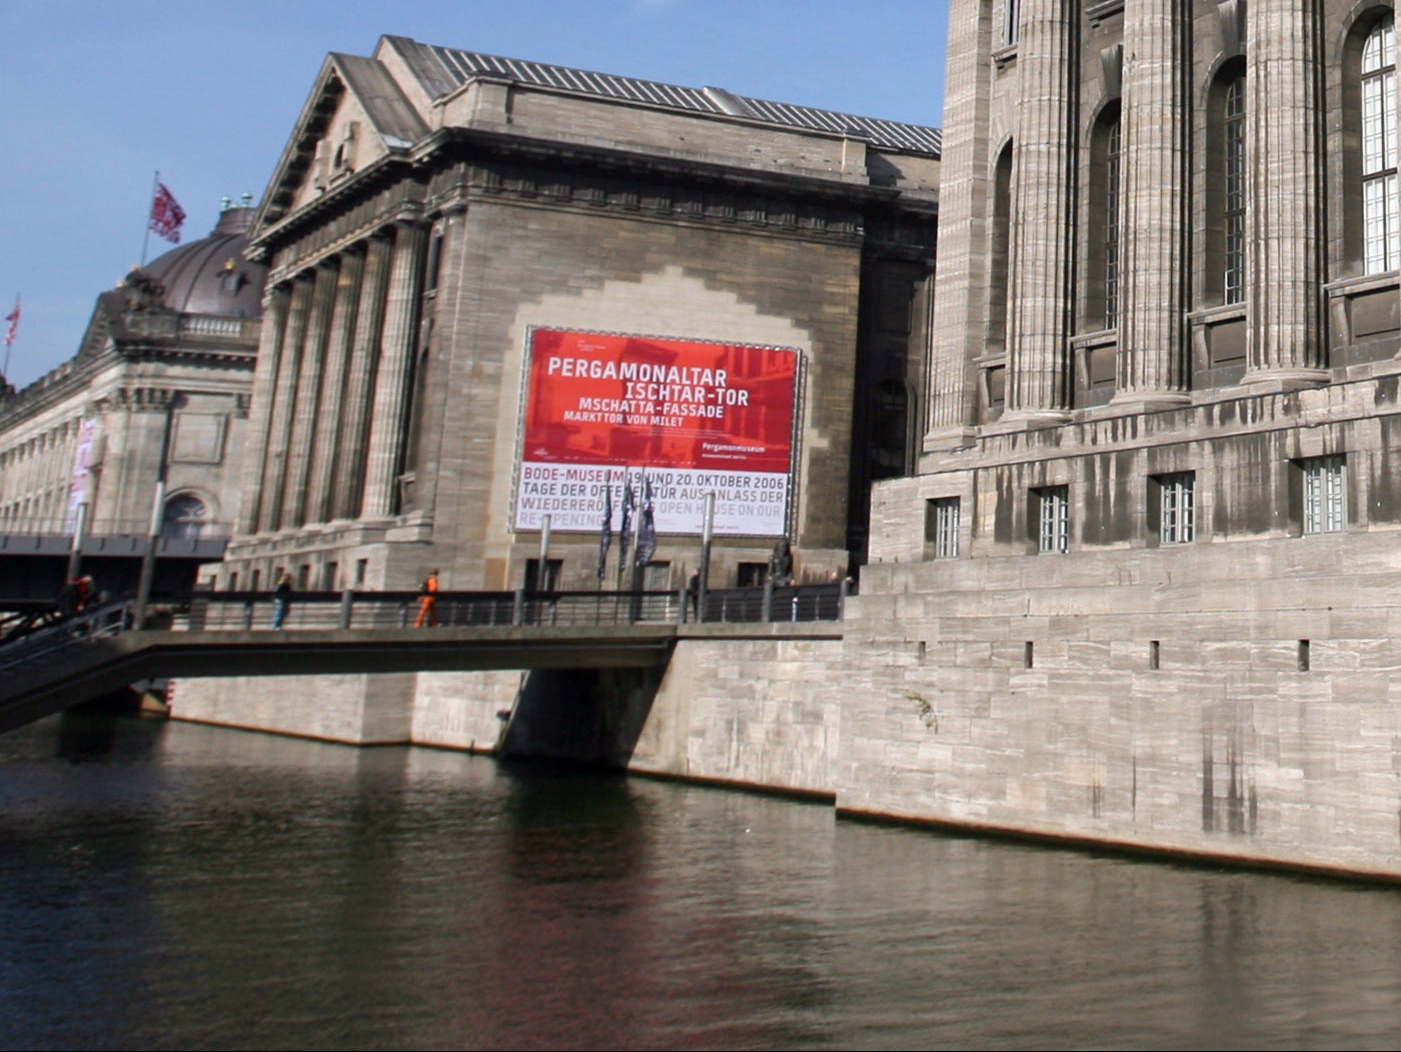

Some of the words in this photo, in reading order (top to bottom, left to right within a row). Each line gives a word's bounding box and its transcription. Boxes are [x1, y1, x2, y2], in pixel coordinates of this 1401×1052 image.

[548, 356, 727, 387] PERGAMONALTAR
[625, 382, 748, 406] ISCHTAR-TOR
[579, 397, 724, 418] MSCHATTA-FASSADE
[563, 410, 623, 424] MARKTTOR
[626, 414, 648, 425] VON
[650, 416, 684, 427] MILET
[647, 473, 673, 486] UND
[696, 475, 751, 488] OKTOBER
[753, 477, 784, 489] 2006
[523, 482, 558, 496] TAGE
[560, 483, 587, 497] DER
[680, 488, 705, 501] AUS
[760, 491, 783, 503] DER
[660, 500, 693, 514] OPEN
[695, 503, 733, 516] HUSE
[739, 504, 755, 517] ON
[519, 511, 605, 526] RE-PENING
